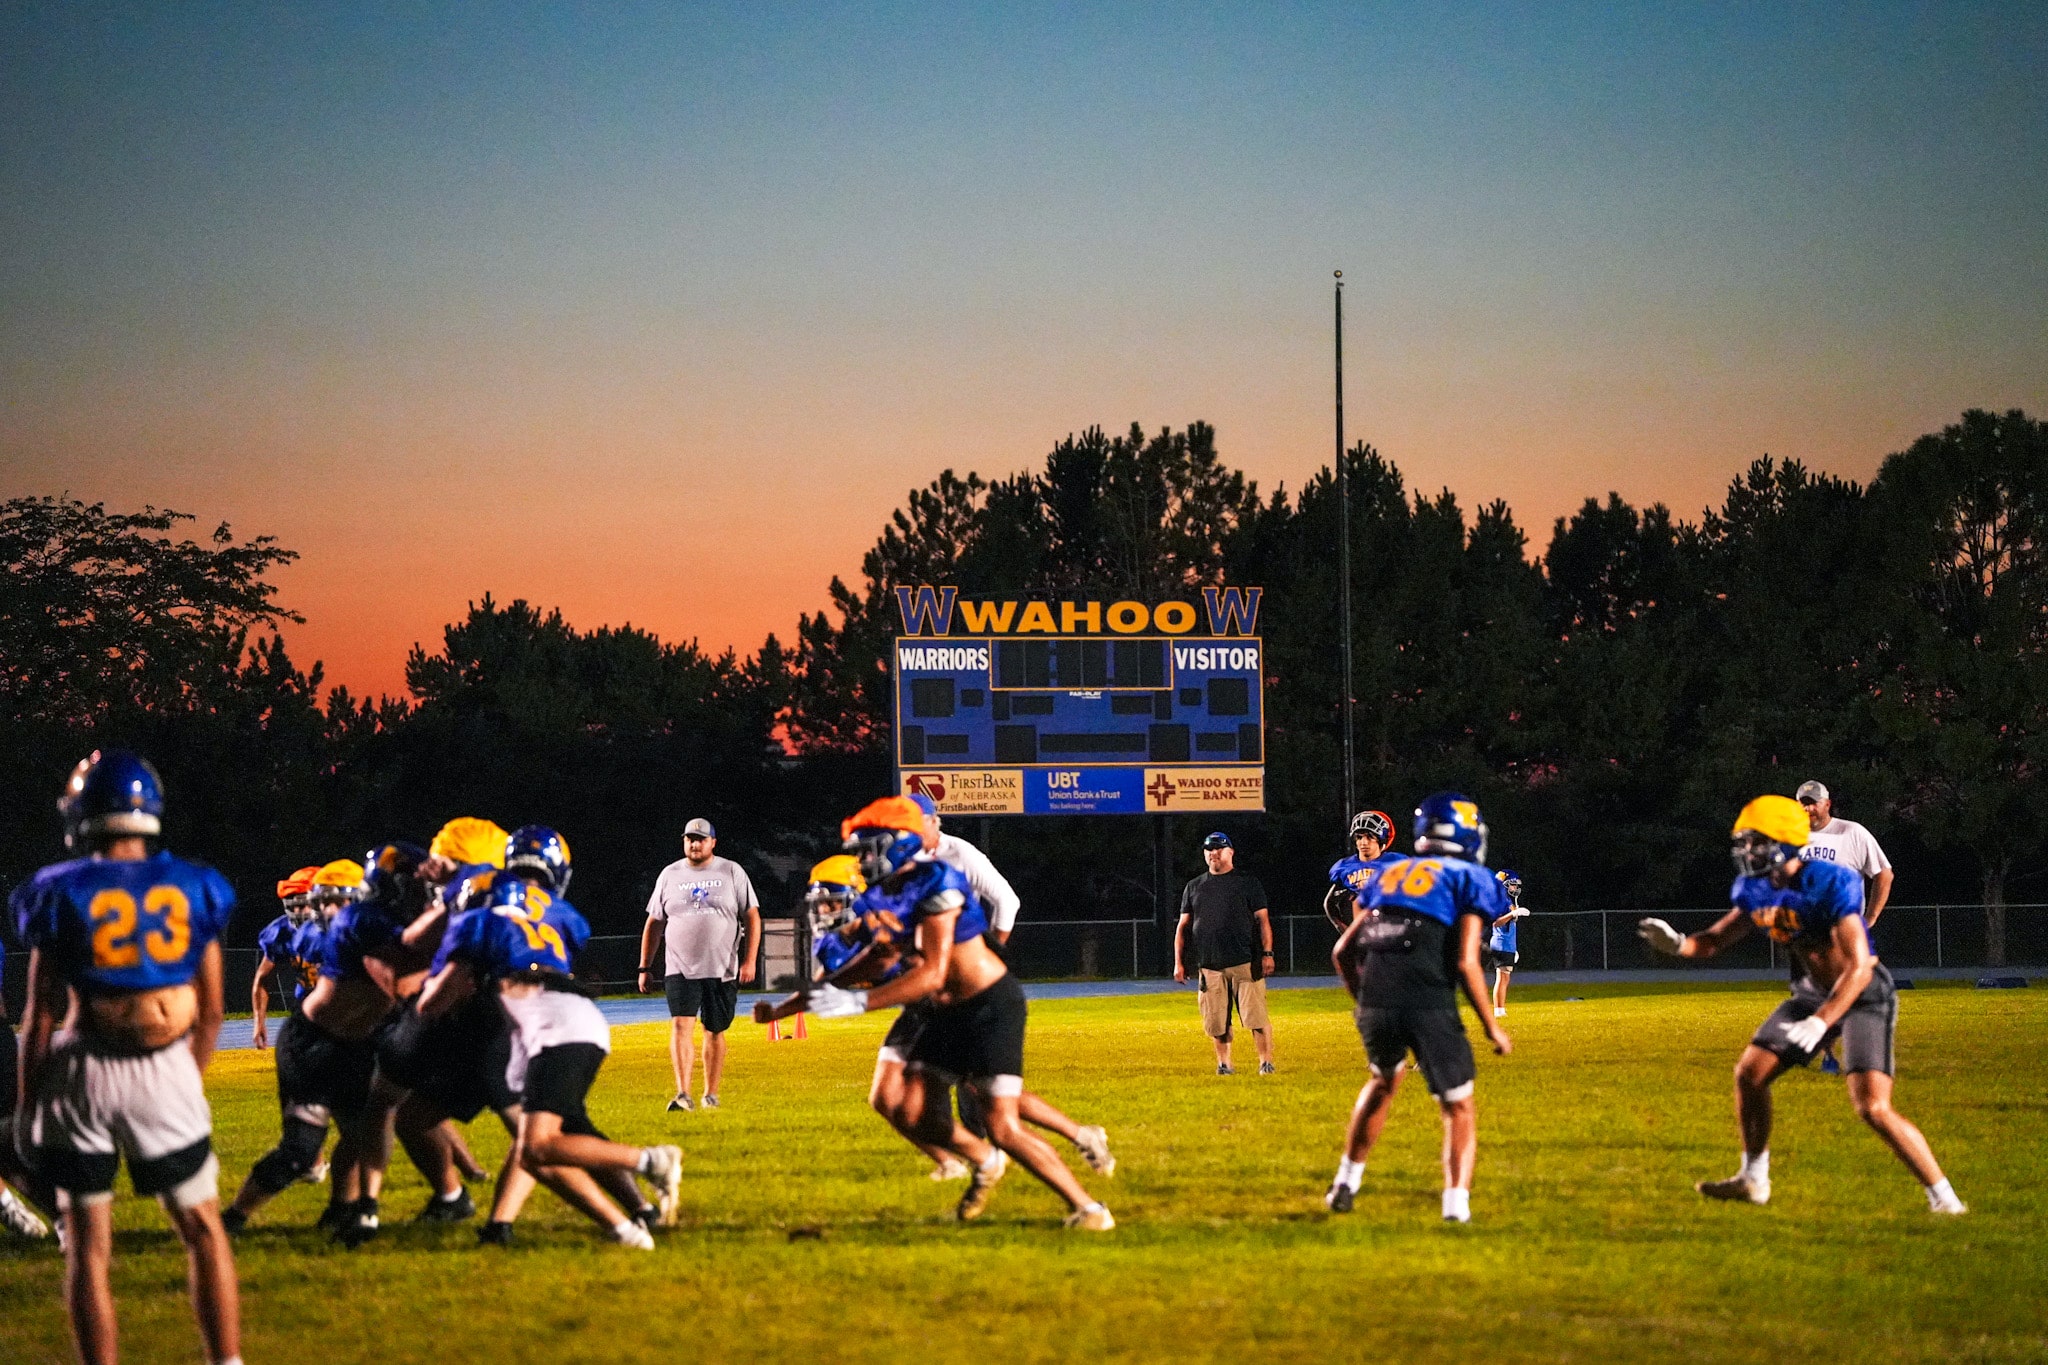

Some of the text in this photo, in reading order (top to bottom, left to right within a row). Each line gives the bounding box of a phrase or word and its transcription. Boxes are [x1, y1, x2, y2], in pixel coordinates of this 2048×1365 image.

[894, 585, 1263, 636] W WAHOO W
[899, 647, 989, 671] WARRIORS
[1174, 647, 1258, 671] VISITOR
[1047, 772, 1080, 789] UBT
[1177, 777, 1262, 788] WAHOO STATE
[950, 791, 1017, 802] of NEBRASKA
[1048, 790, 1072, 799] Union
[1072, 790, 1094, 799] Bank
[1100, 790, 1121, 799] Trust
[1202, 790, 1237, 800] BANK
[1799, 847, 1836, 861] AHOO
[678, 879, 722, 891] WAHOO
[1378, 859, 1443, 897] 46
[89, 884, 191, 968] 23
